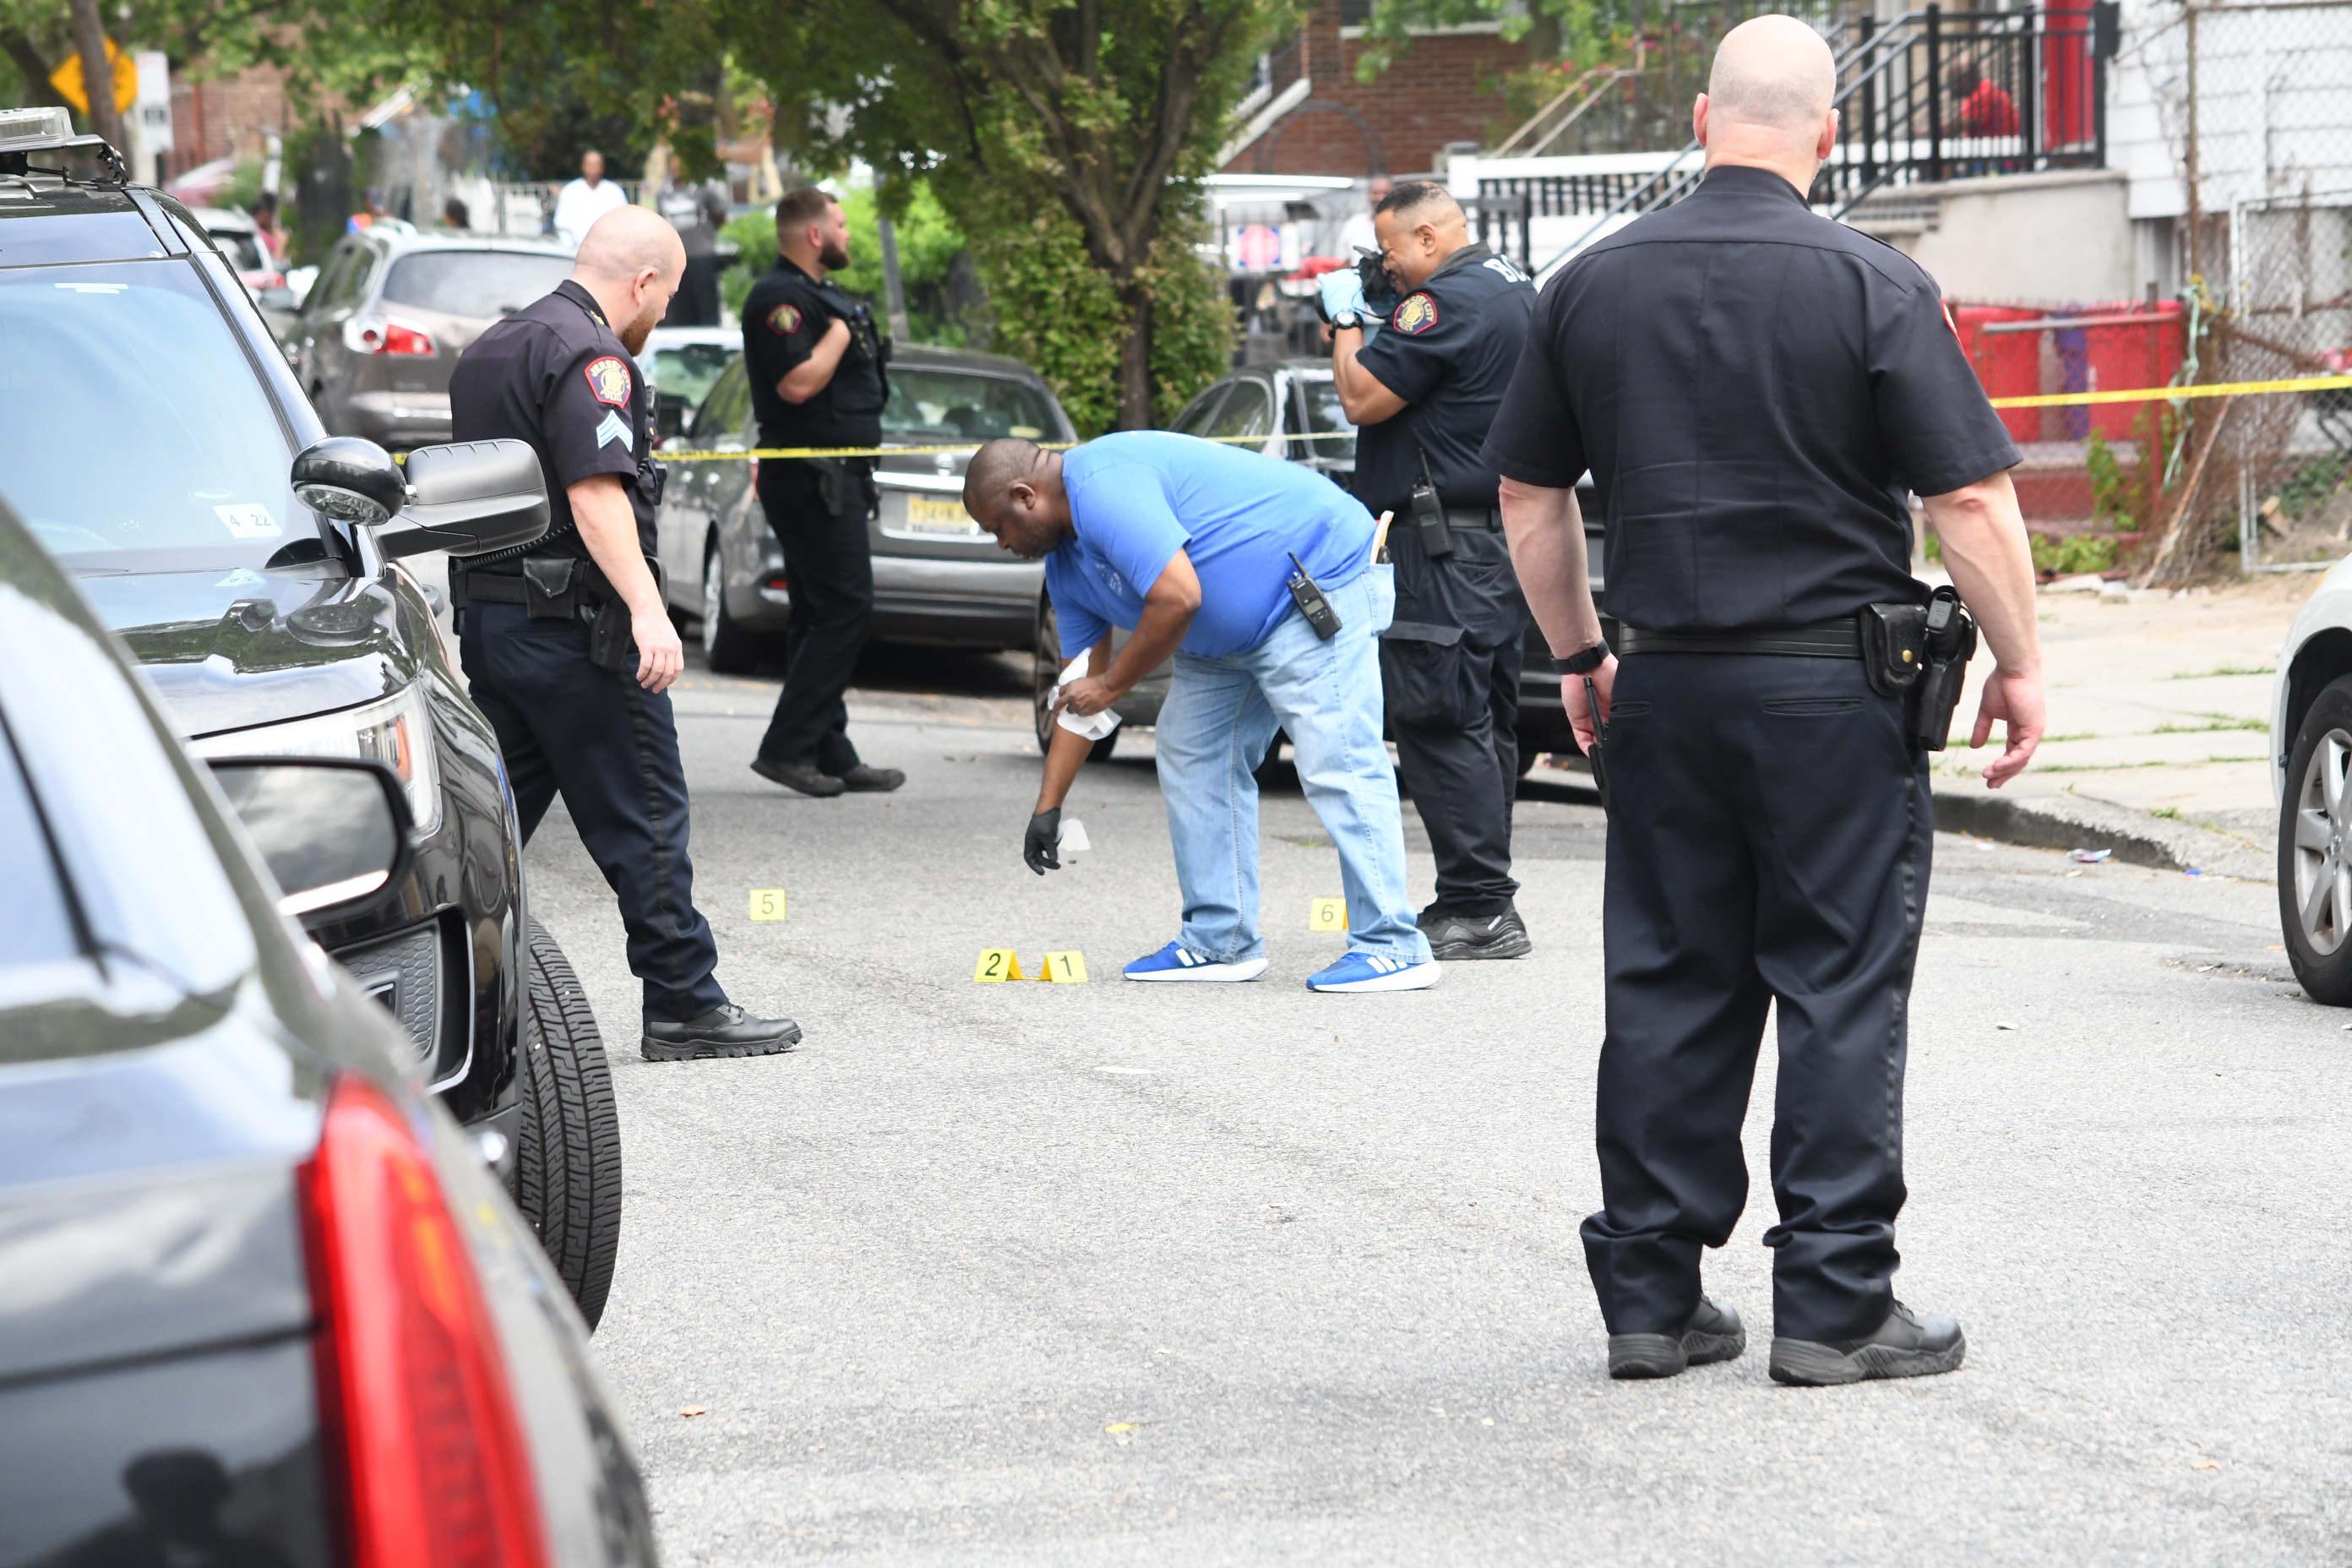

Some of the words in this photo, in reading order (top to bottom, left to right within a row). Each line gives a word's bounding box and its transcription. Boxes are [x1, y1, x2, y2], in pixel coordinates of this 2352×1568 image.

[1483, 254, 1532, 283] BC
[1424, 302, 1435, 323] CITY
[590, 359, 623, 378] JERSEY
[250, 513, 271, 526] 22
[761, 893, 775, 915] 5
[1321, 904, 1334, 923] 6
[984, 952, 1001, 977] 2
[1059, 955, 1072, 977] 1
